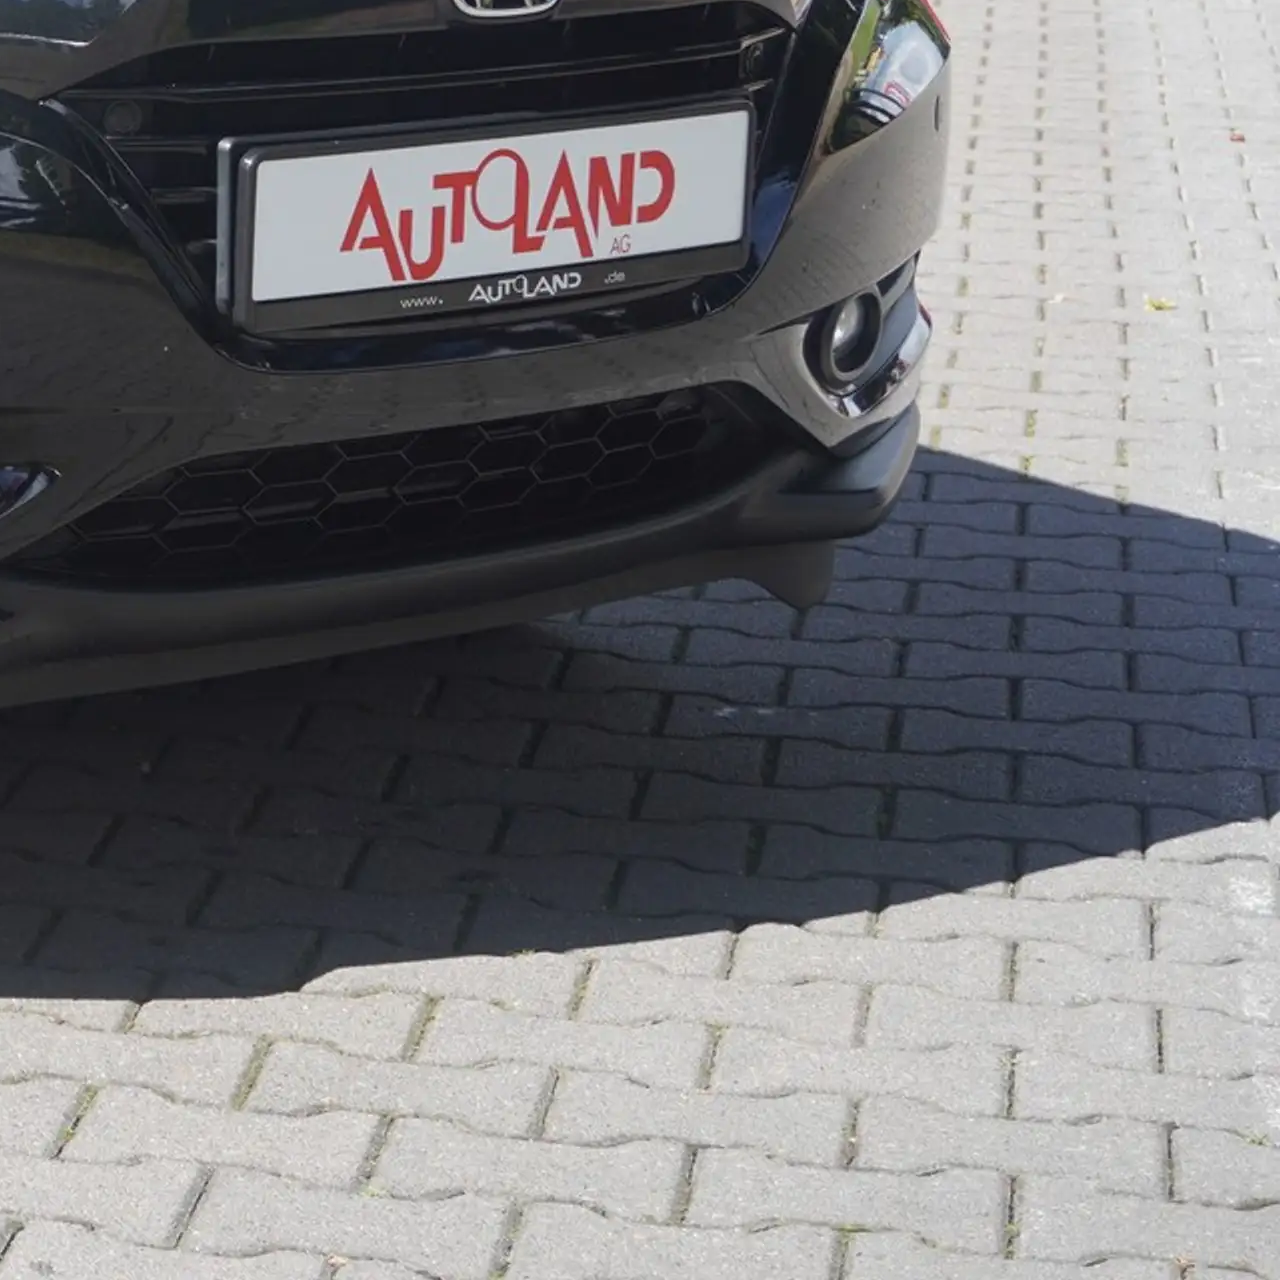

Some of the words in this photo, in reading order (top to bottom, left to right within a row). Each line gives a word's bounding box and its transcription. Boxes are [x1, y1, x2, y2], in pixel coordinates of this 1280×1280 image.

[340, 149, 675, 280] AUTOLAND
[610, 234, 631, 255] AG
[468, 272, 581, 303] AUTOLAND
